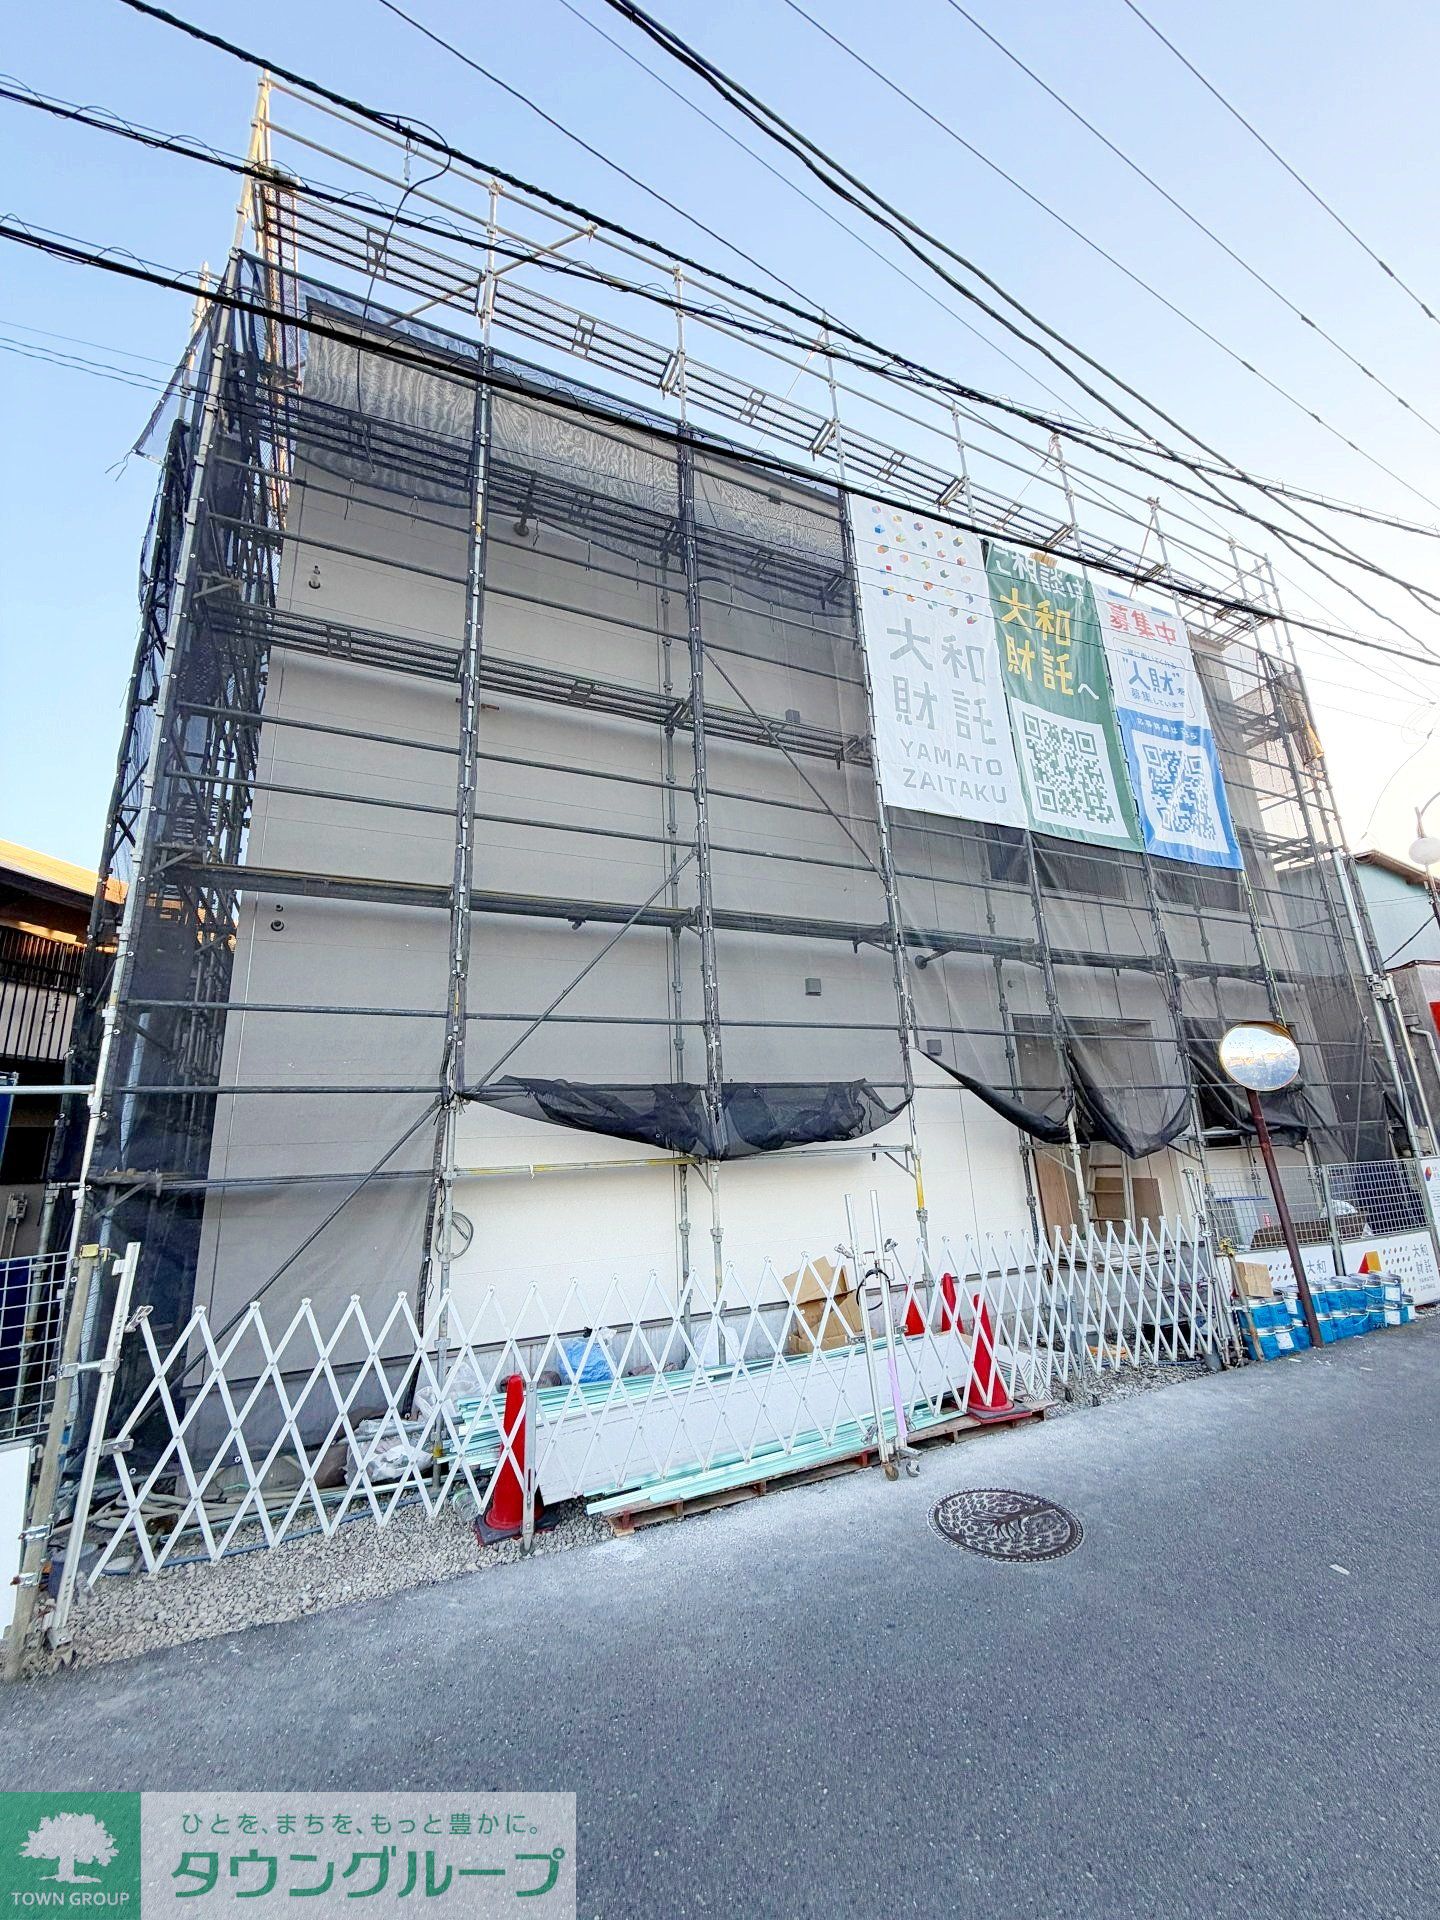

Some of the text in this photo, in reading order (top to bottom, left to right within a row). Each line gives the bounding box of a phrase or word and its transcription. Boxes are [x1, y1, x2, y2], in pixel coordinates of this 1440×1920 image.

[1000, 587, 1071, 647] 大和
[1105, 601, 1176, 646] 募集中
[886, 617, 986, 686] 大和
[892, 675, 997, 745] 財託
[900, 738, 1004, 776] YAMATO
[902, 767, 1007, 804] ZAITAKU
